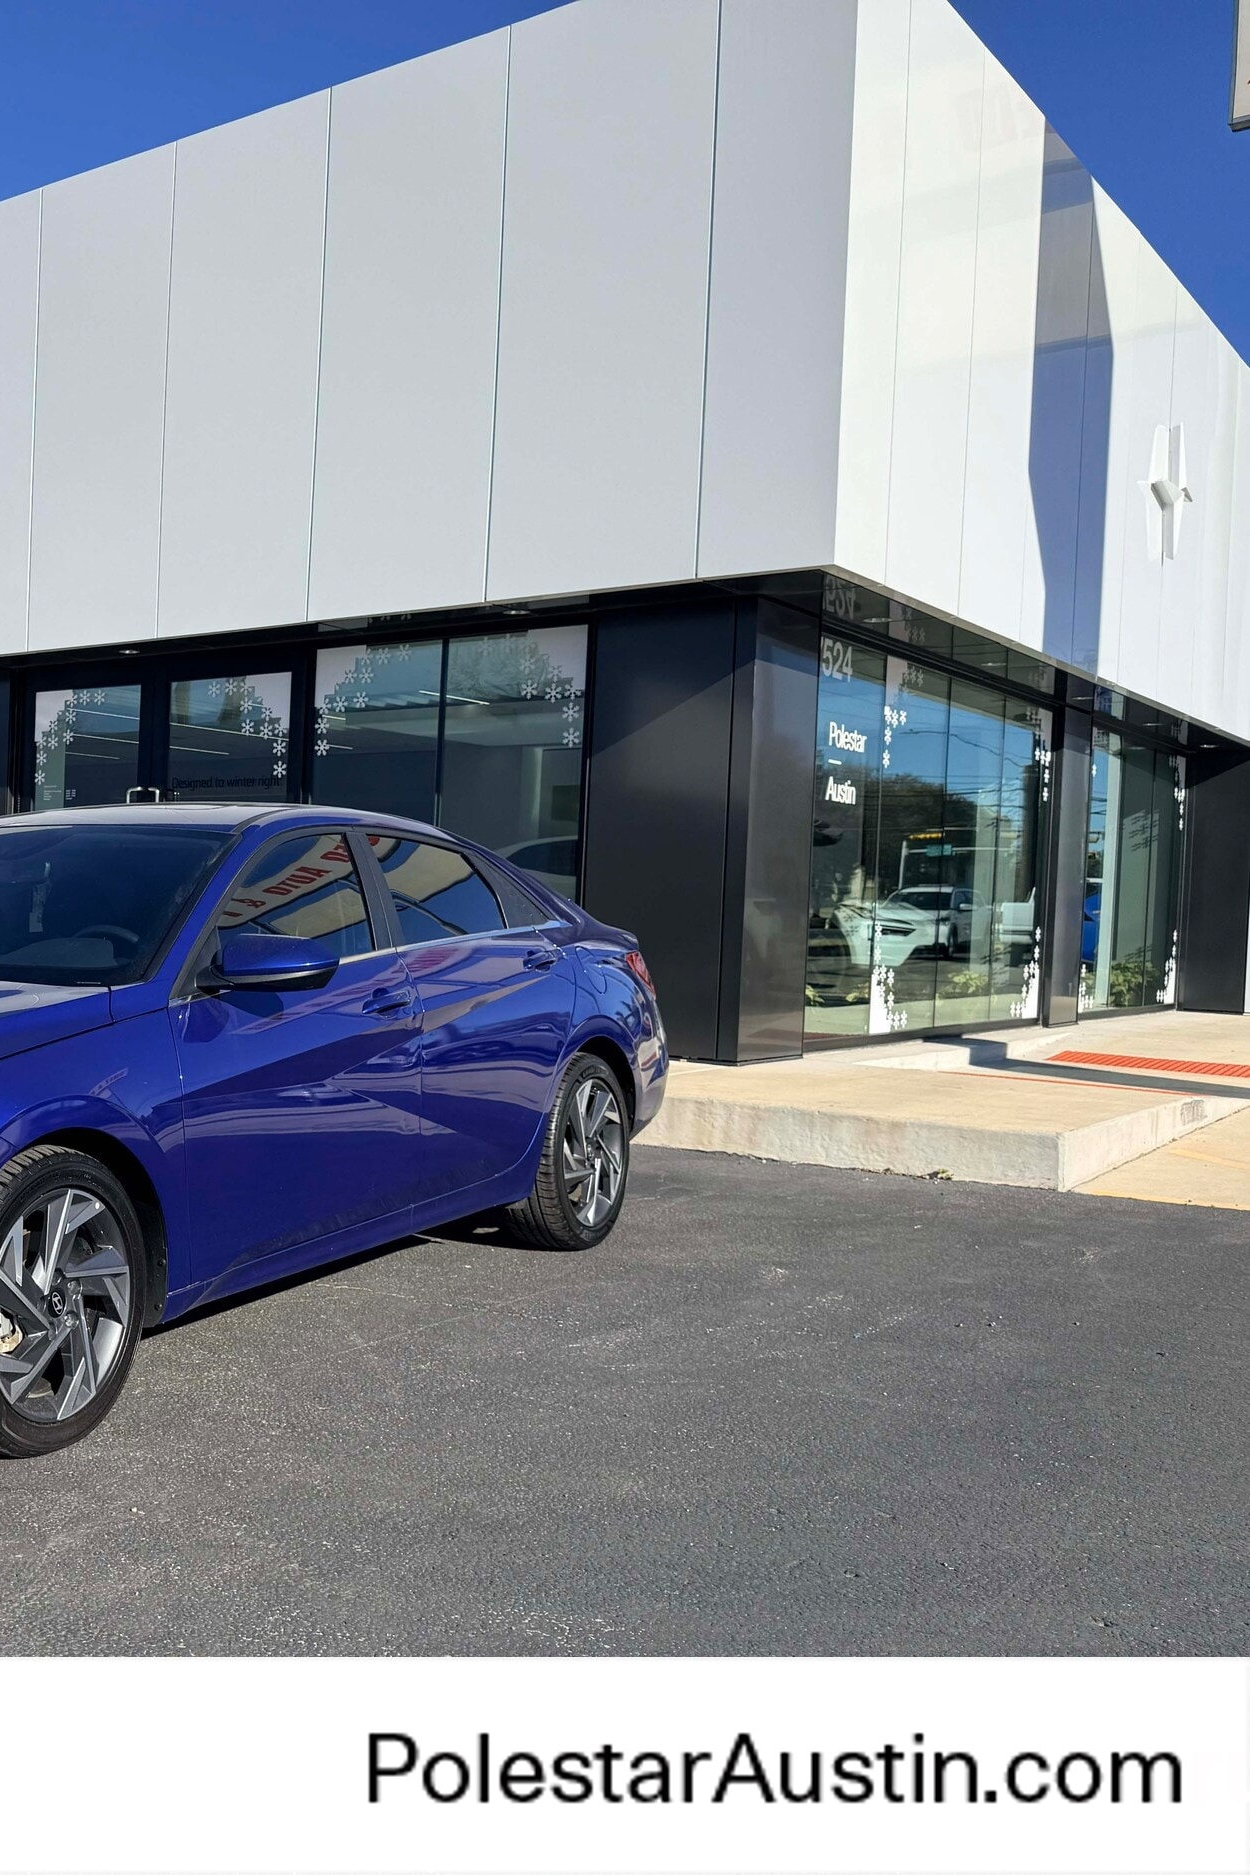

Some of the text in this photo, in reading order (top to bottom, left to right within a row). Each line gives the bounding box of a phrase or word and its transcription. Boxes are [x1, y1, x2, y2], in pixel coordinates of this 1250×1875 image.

[820, 636, 853, 682] 524
[828, 721, 868, 753] Polestar
[172, 776, 213, 791] Designed
[215, 777, 225, 788] to
[226, 776, 256, 788] winter
[825, 776, 856, 805] Austin
